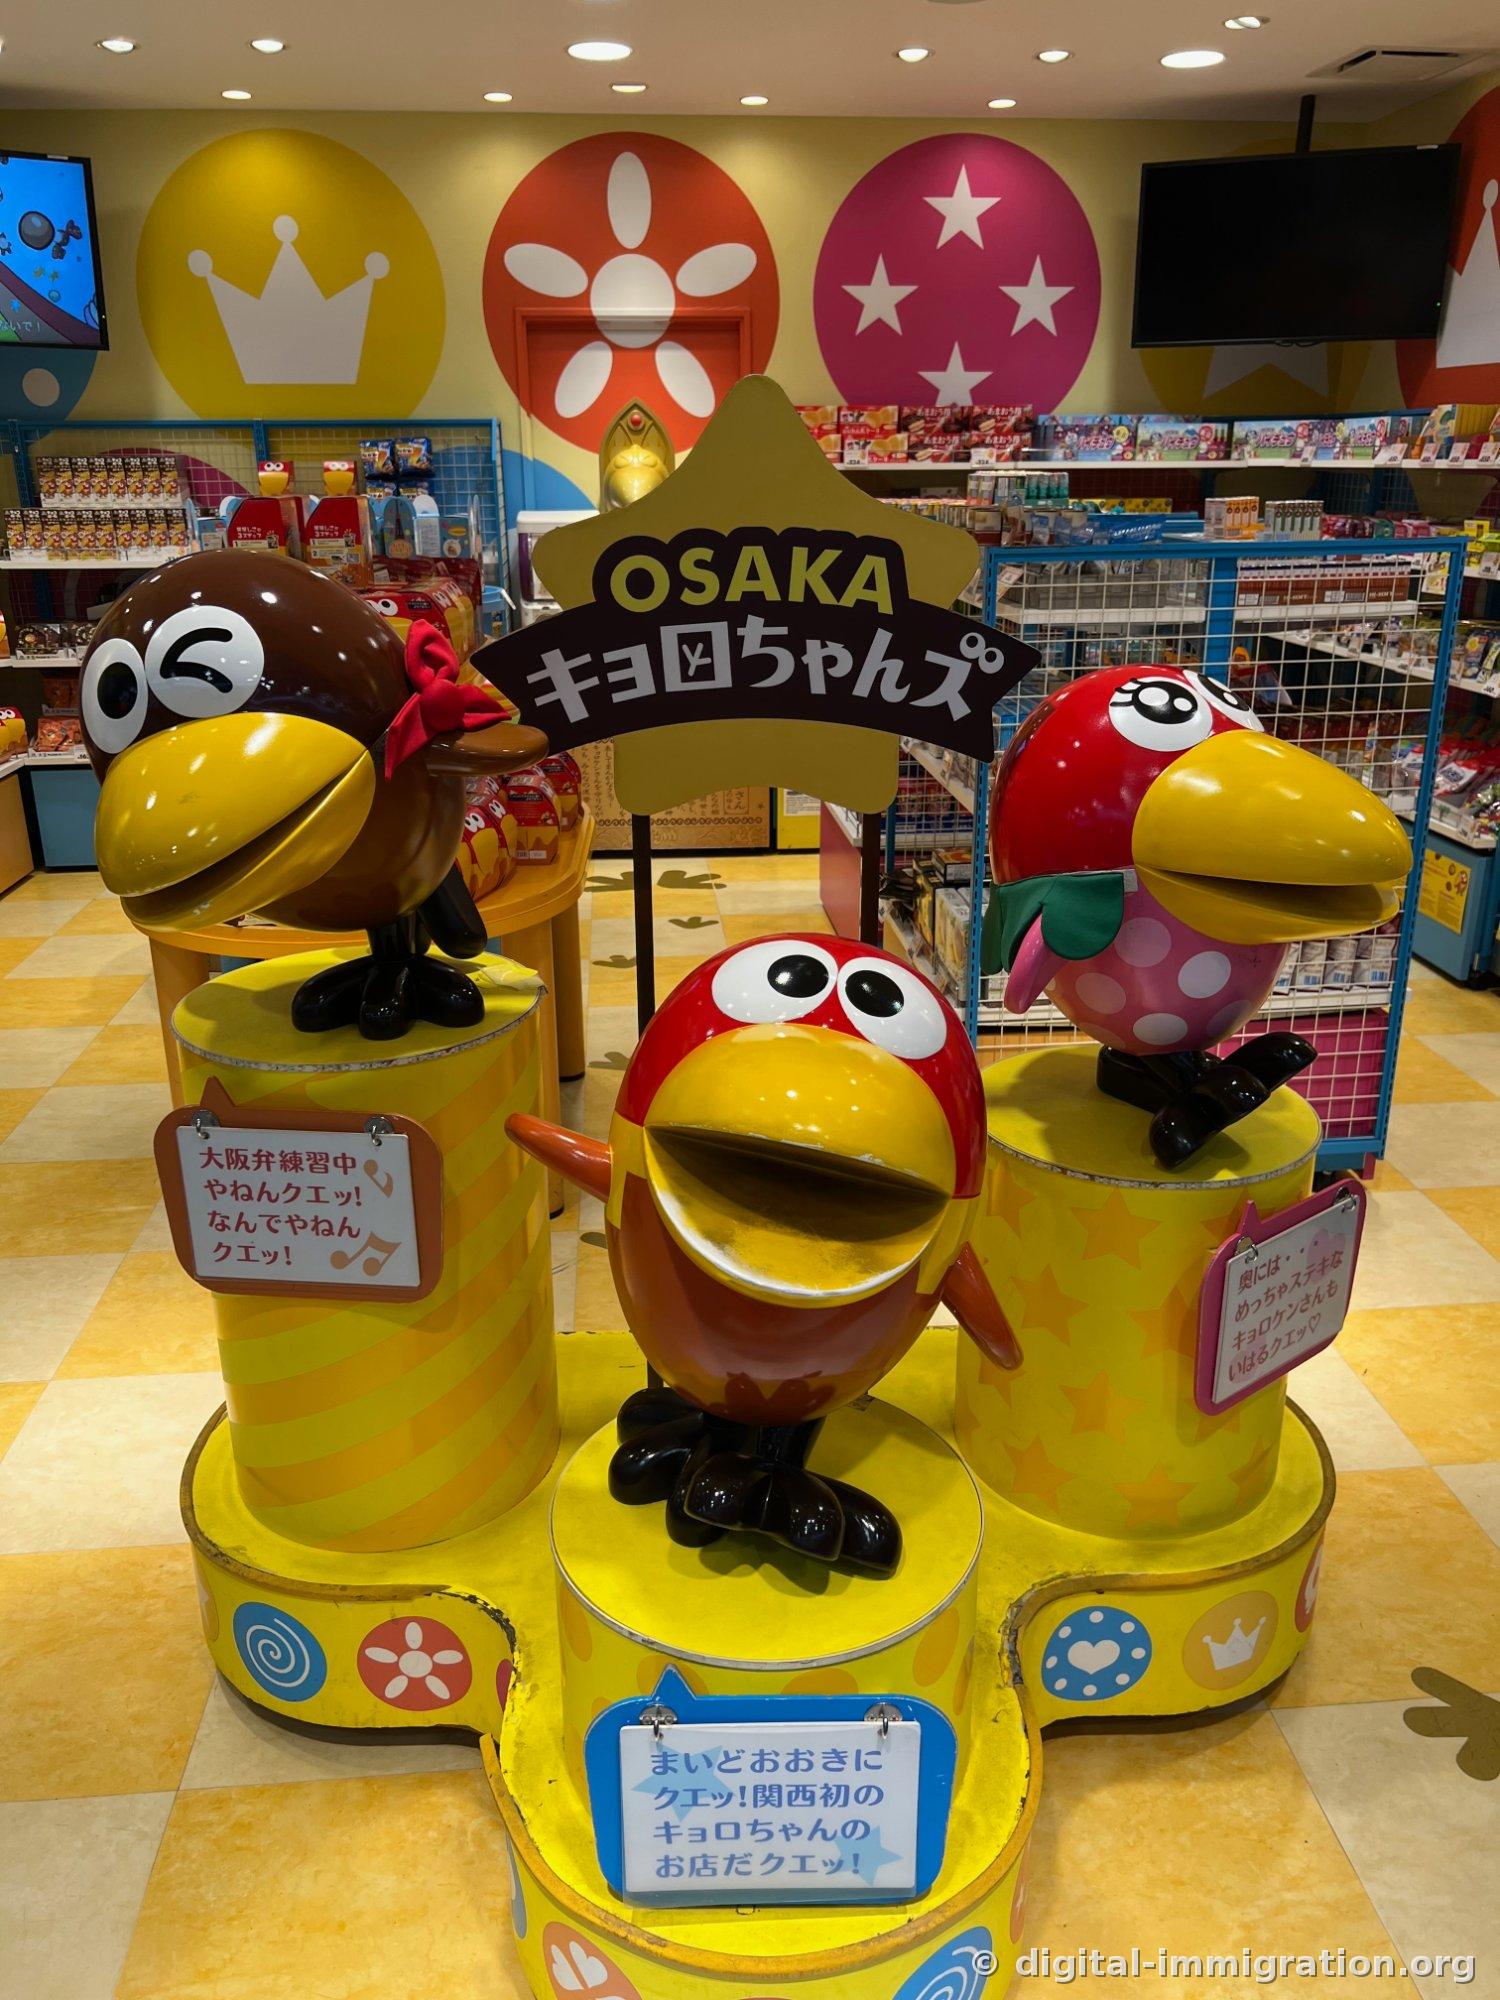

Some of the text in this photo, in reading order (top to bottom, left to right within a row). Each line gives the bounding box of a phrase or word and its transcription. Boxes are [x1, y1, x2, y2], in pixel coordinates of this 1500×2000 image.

[609, 544, 895, 615] OSAKA
[526, 614, 1005, 724] キョロちゃんズ
[199, 1147, 356, 1176] 大阪弁練習中
[203, 1179, 362, 1207] やねんクエッ!
[207, 1210, 361, 1239] なんでやねん
[211, 1241, 292, 1266] クエッ!
[1234, 1249, 1344, 1322] めっちゃステキな
[1232, 1279, 1338, 1352] キョロケンさんも
[650, 1748, 884, 1776] まいどおおきに
[653, 1783, 884, 1810] クエッ!関西初の
[652, 1818, 871, 1844] キョロちゃんの
[656, 1852, 861, 1879] お店だクエッ!
